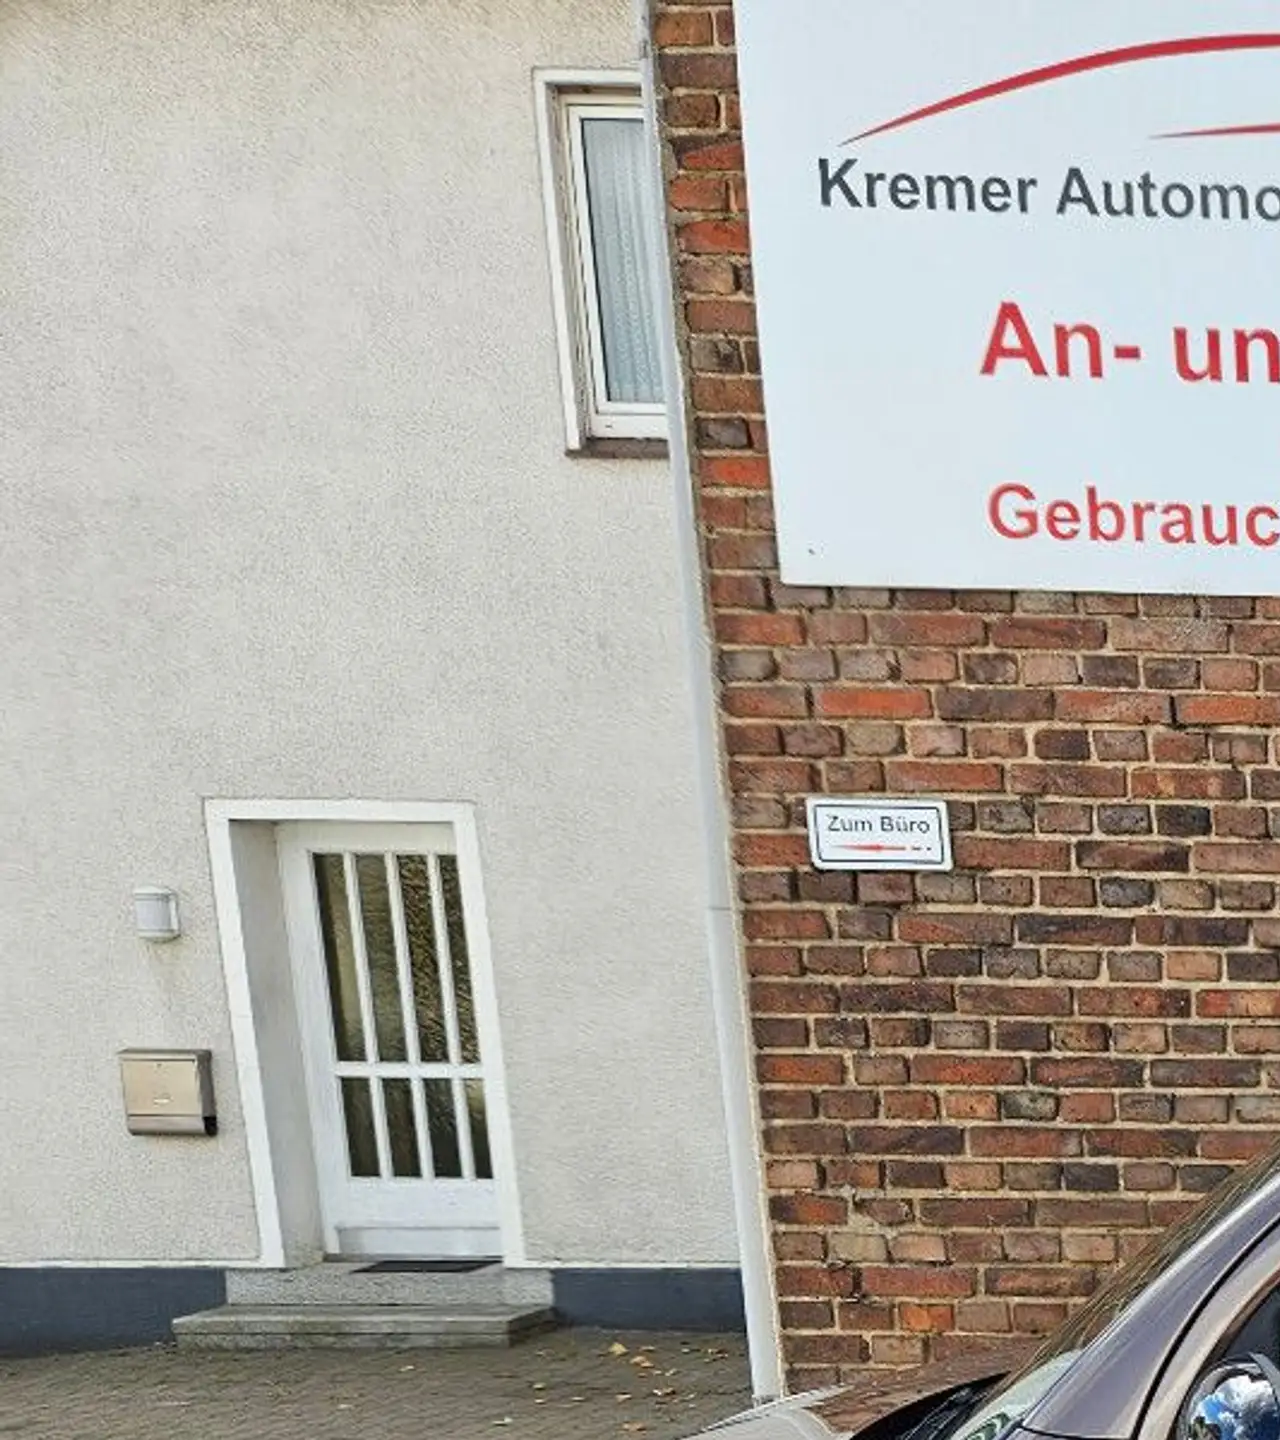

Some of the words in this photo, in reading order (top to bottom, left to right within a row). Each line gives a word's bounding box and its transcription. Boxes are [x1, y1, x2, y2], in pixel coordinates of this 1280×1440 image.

[818, 157, 1038, 214] Kremer
[979, 301, 1141, 379] An-
[827, 815, 873, 832] Zum
[880, 815, 930, 834] Büro
